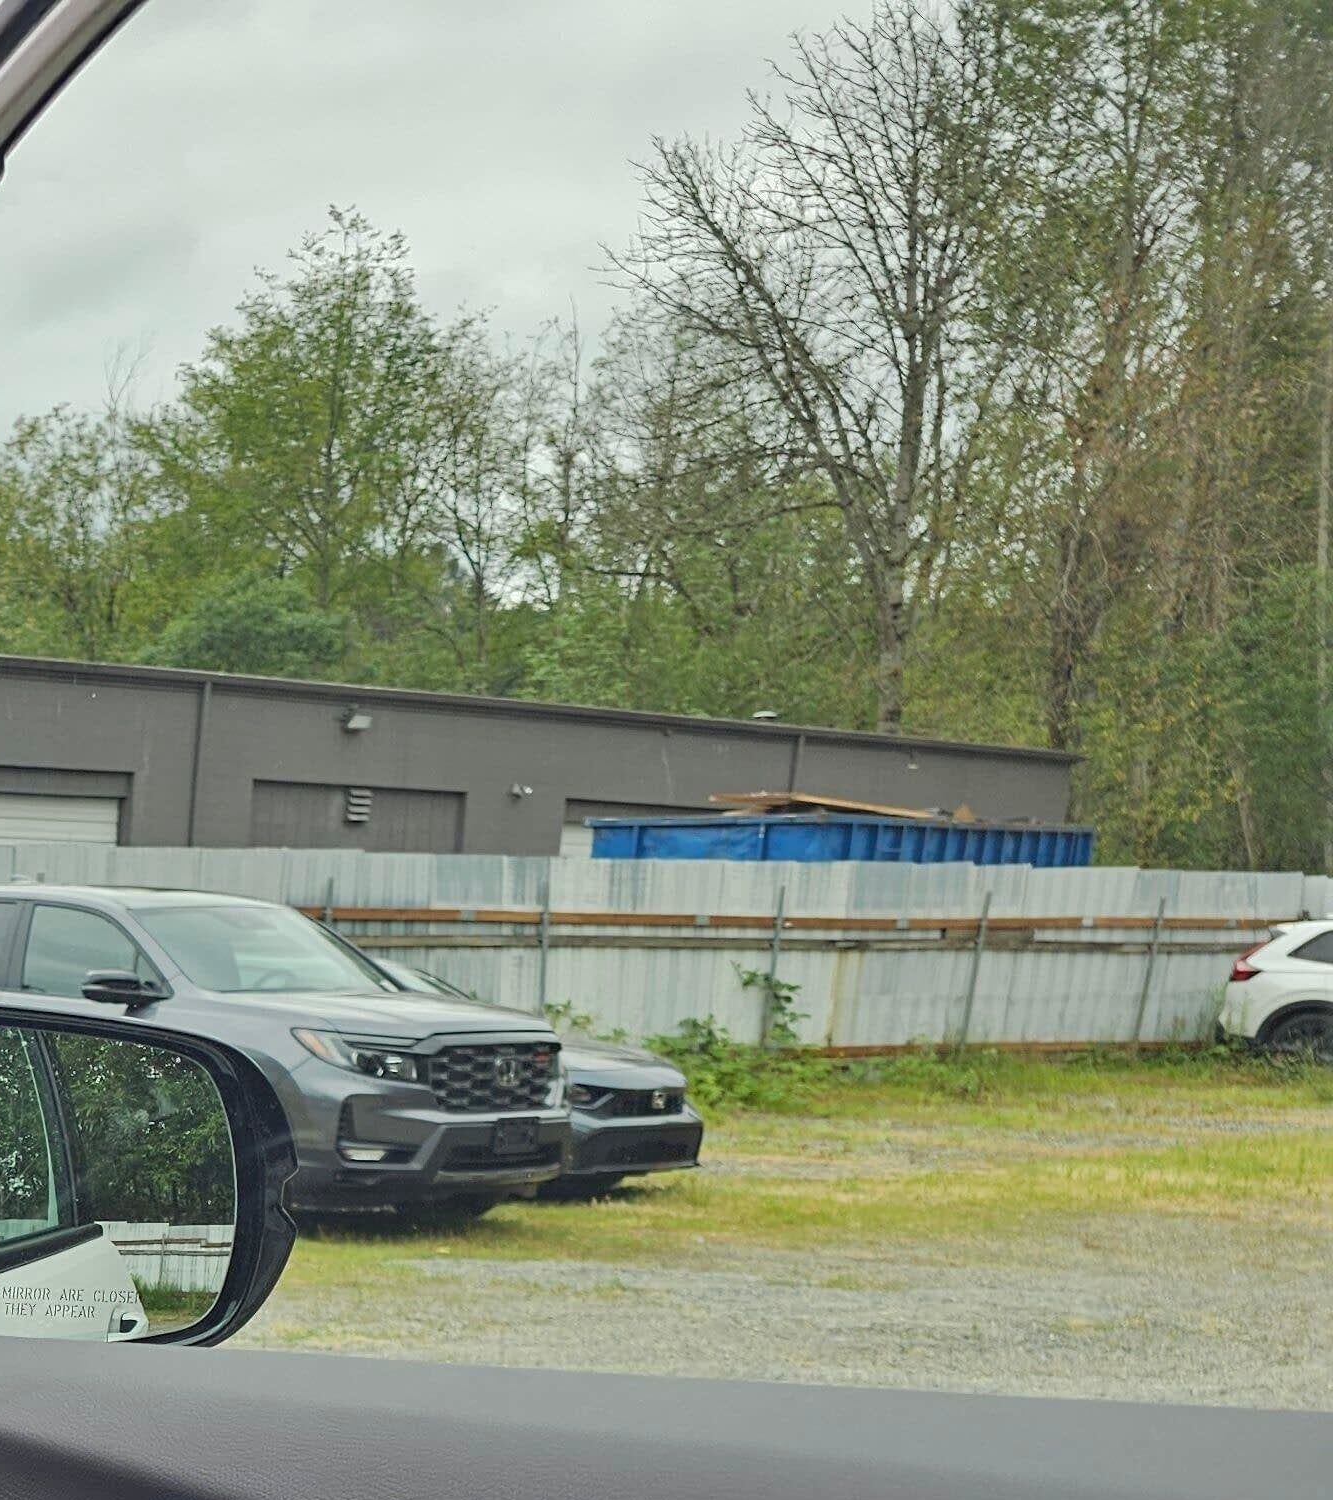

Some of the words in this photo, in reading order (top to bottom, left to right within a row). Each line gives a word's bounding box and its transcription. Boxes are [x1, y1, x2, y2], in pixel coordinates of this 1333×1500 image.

[3, 1287, 50, 1300] MIRROR
[60, 1289, 83, 1302] ARE
[5, 1303, 36, 1317] THEY
[45, 1304, 95, 1319] APPEAR
